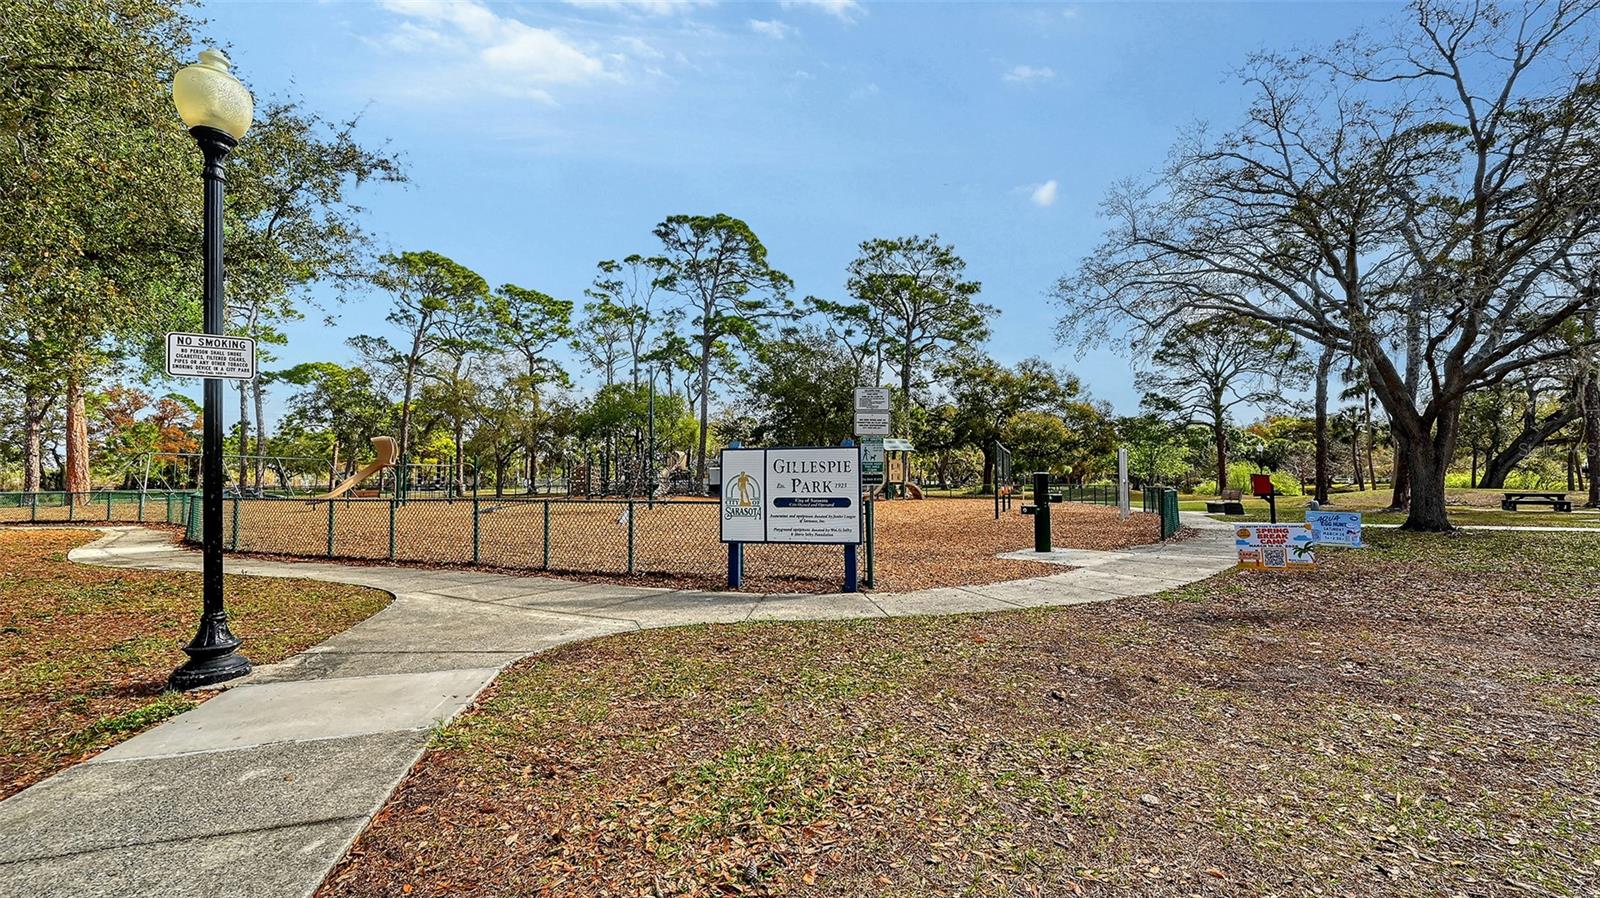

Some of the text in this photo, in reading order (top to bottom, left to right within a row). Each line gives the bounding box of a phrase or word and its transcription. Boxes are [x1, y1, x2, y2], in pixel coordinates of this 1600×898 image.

[177, 336, 246, 349] NO SMOKING
[774, 458, 852, 474] GILLESPIE
[791, 478, 833, 493] PARK
[724, 507, 761, 520] SARASOTA
